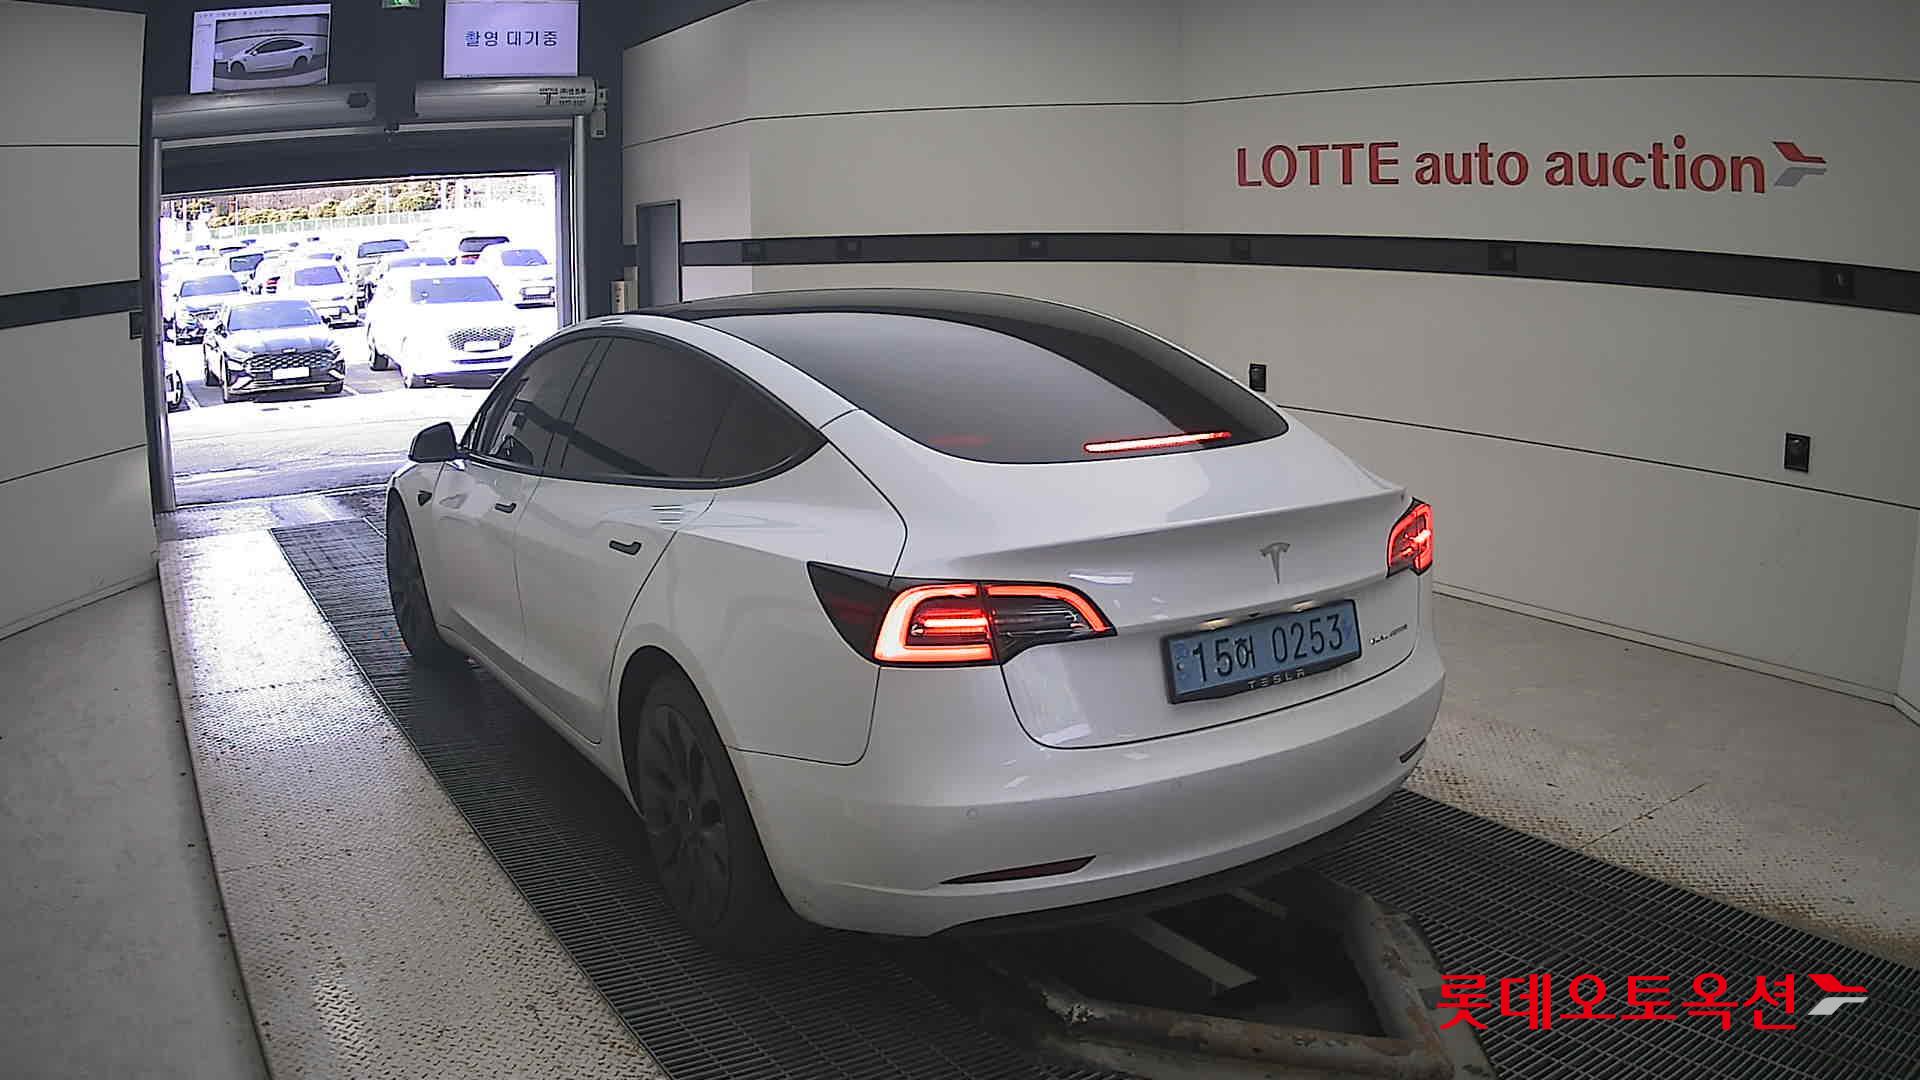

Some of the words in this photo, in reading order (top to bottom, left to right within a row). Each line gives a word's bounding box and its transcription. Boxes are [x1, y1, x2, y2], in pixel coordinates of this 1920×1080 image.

[506, 30, 558, 47] 대기중
[1237, 141, 1399, 188] LOTTE
[1415, 142, 1529, 186] auto
[1545, 134, 1765, 194] auction
[1192, 635, 1256, 682] 15허
[1271, 614, 1343, 664] 0253
[1248, 668, 1305, 689] TESLA
